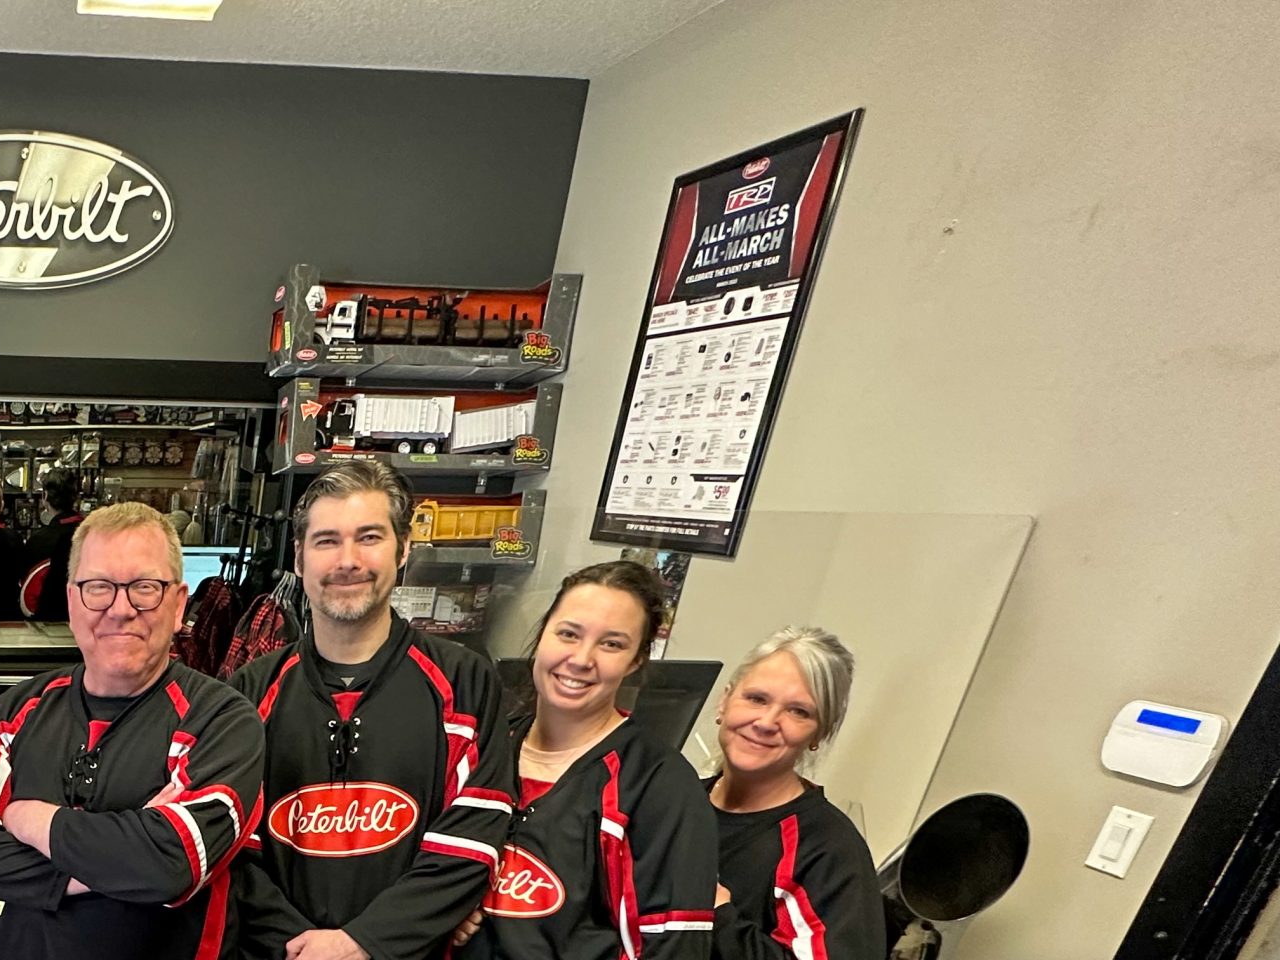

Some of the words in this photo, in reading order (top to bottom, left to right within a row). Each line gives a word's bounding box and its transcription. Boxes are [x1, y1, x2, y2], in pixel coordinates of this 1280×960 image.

[729, 184, 773, 209] TRP
[698, 203, 791, 247] ALL-MAKES
[692, 228, 785, 269] ALL-MARCH
[685, 270, 715, 284] CELEBRATE
[714, 267, 726, 277] THE
[725, 264, 743, 275] EVENT
[742, 261, 752, 271] OF
[752, 258, 764, 268] THE
[763, 255, 780, 266] YEAR
[527, 332, 549, 346] Big
[524, 345, 553, 356] Roads
[520, 438, 539, 449] Big
[515, 448, 541, 458] Roads
[498, 528, 521, 542] Big
[495, 540, 524, 552] Roads
[288, 799, 408, 837] Peterbilt
